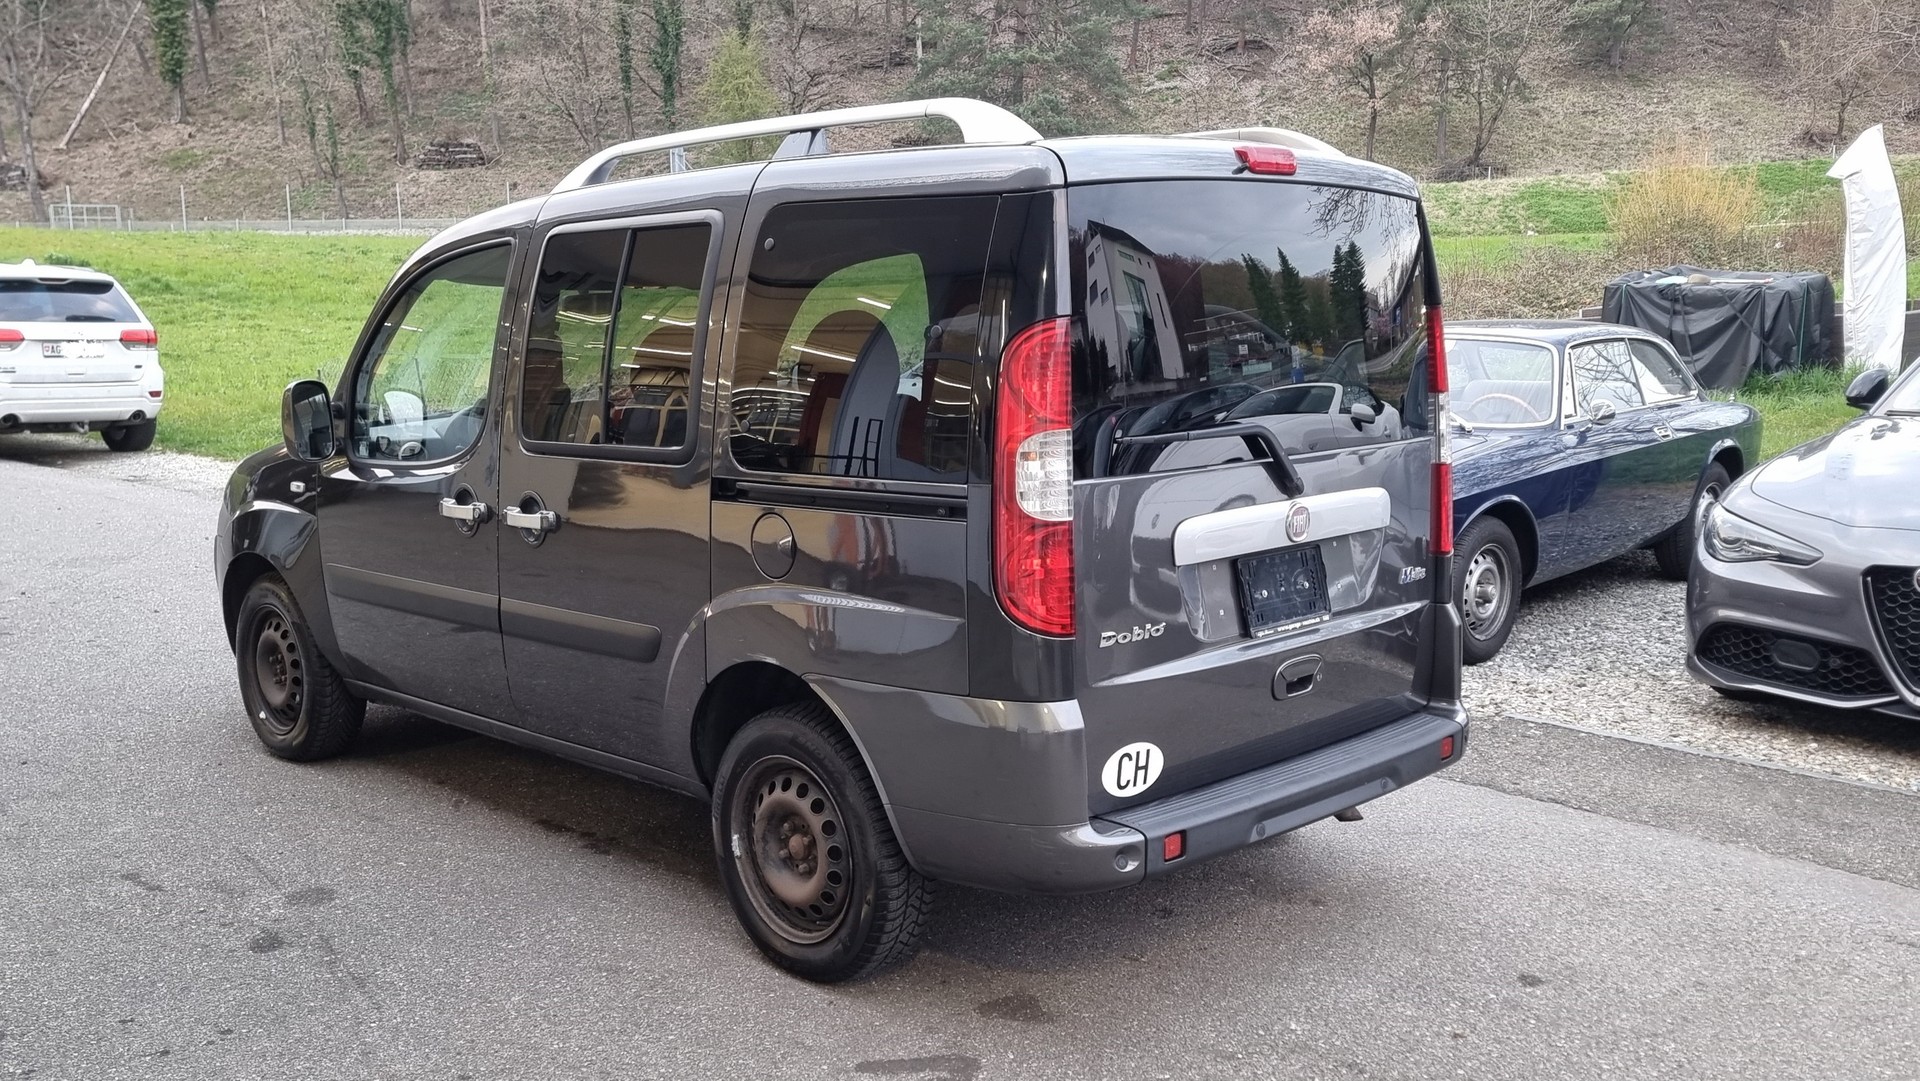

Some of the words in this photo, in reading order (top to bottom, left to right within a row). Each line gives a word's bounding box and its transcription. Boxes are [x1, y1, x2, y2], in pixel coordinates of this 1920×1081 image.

[50, 345, 62, 354] AG
[1293, 514, 1307, 533] FIAT
[1116, 748, 1151, 791] CH
